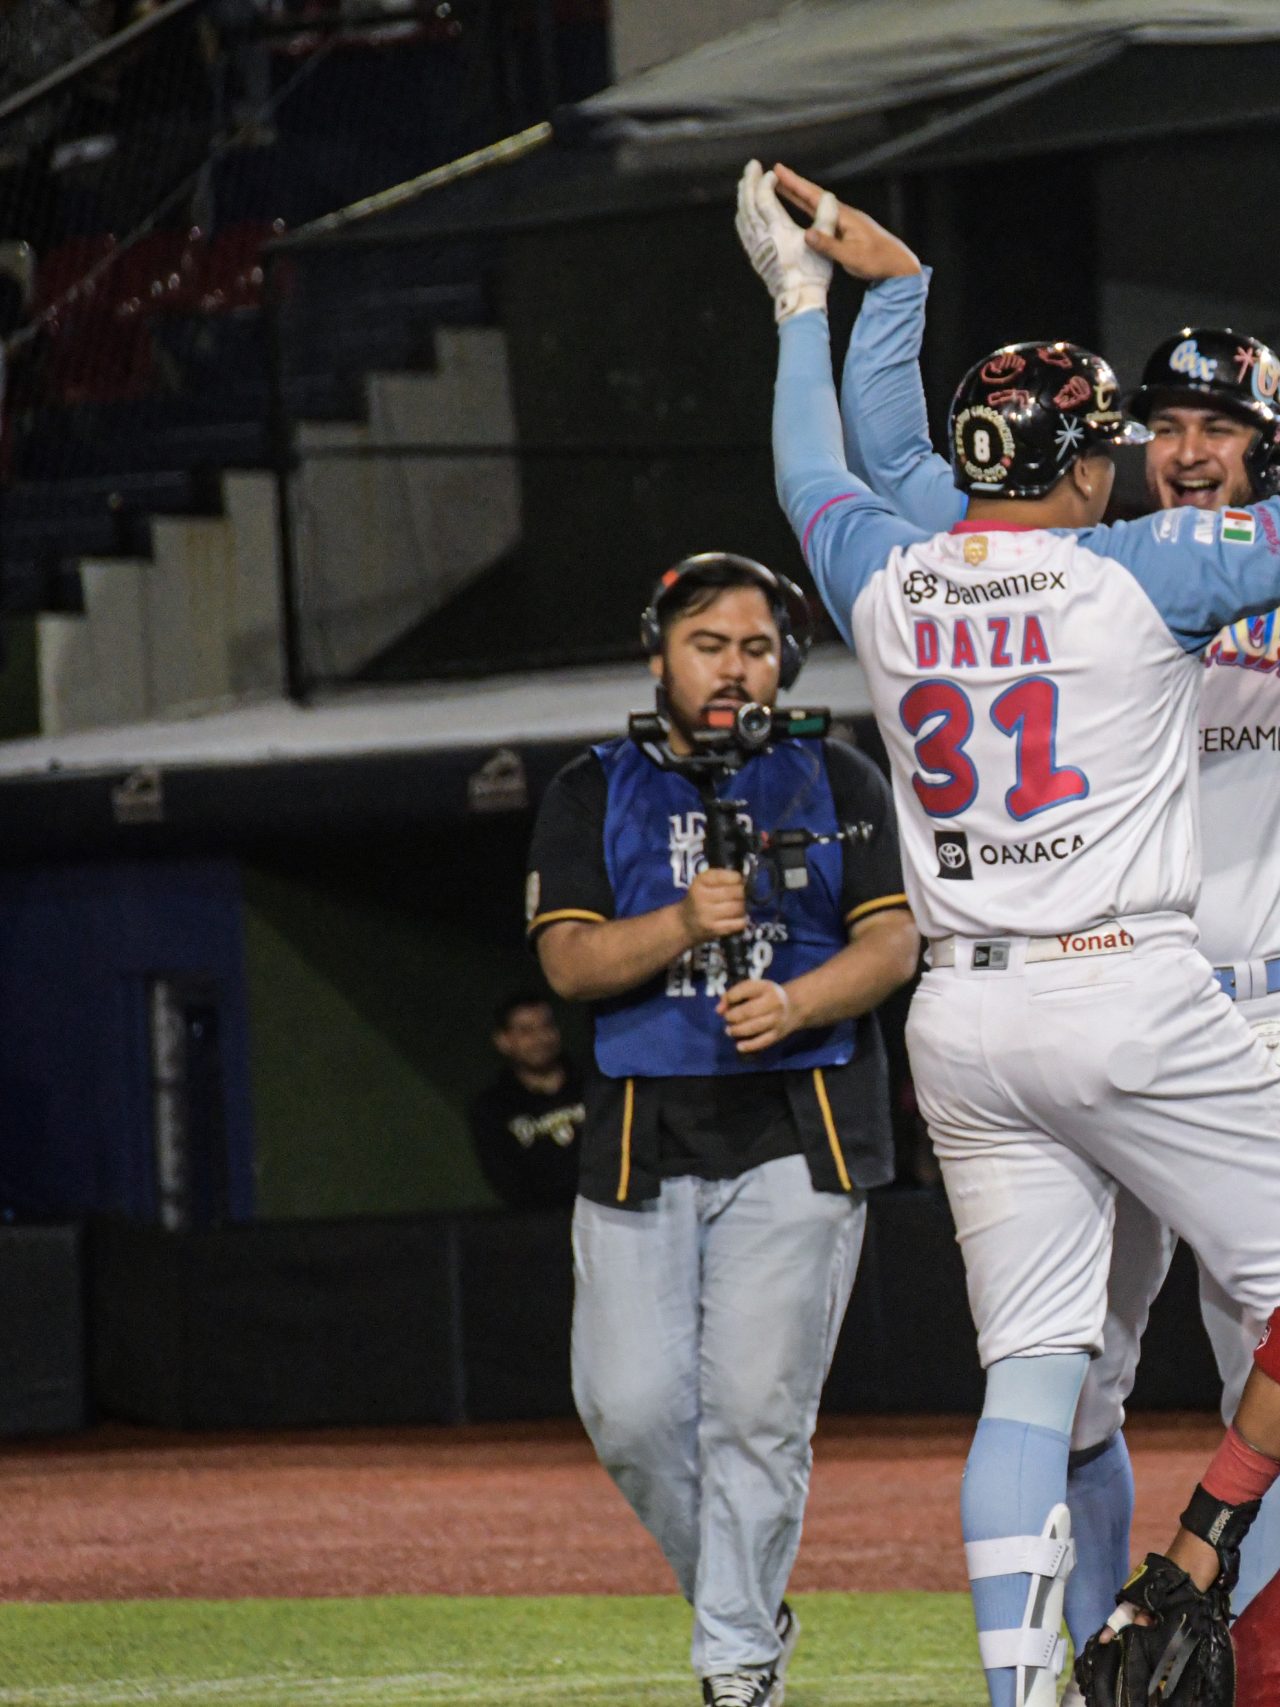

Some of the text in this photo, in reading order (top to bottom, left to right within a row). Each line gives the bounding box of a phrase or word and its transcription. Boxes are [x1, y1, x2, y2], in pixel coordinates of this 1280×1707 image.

[973, 429, 991, 463] 8
[944, 570, 1067, 605] Banamex
[913, 615, 1052, 670] DAZA
[900, 676, 1090, 822] 31
[979, 834, 1085, 866] OAXACA
